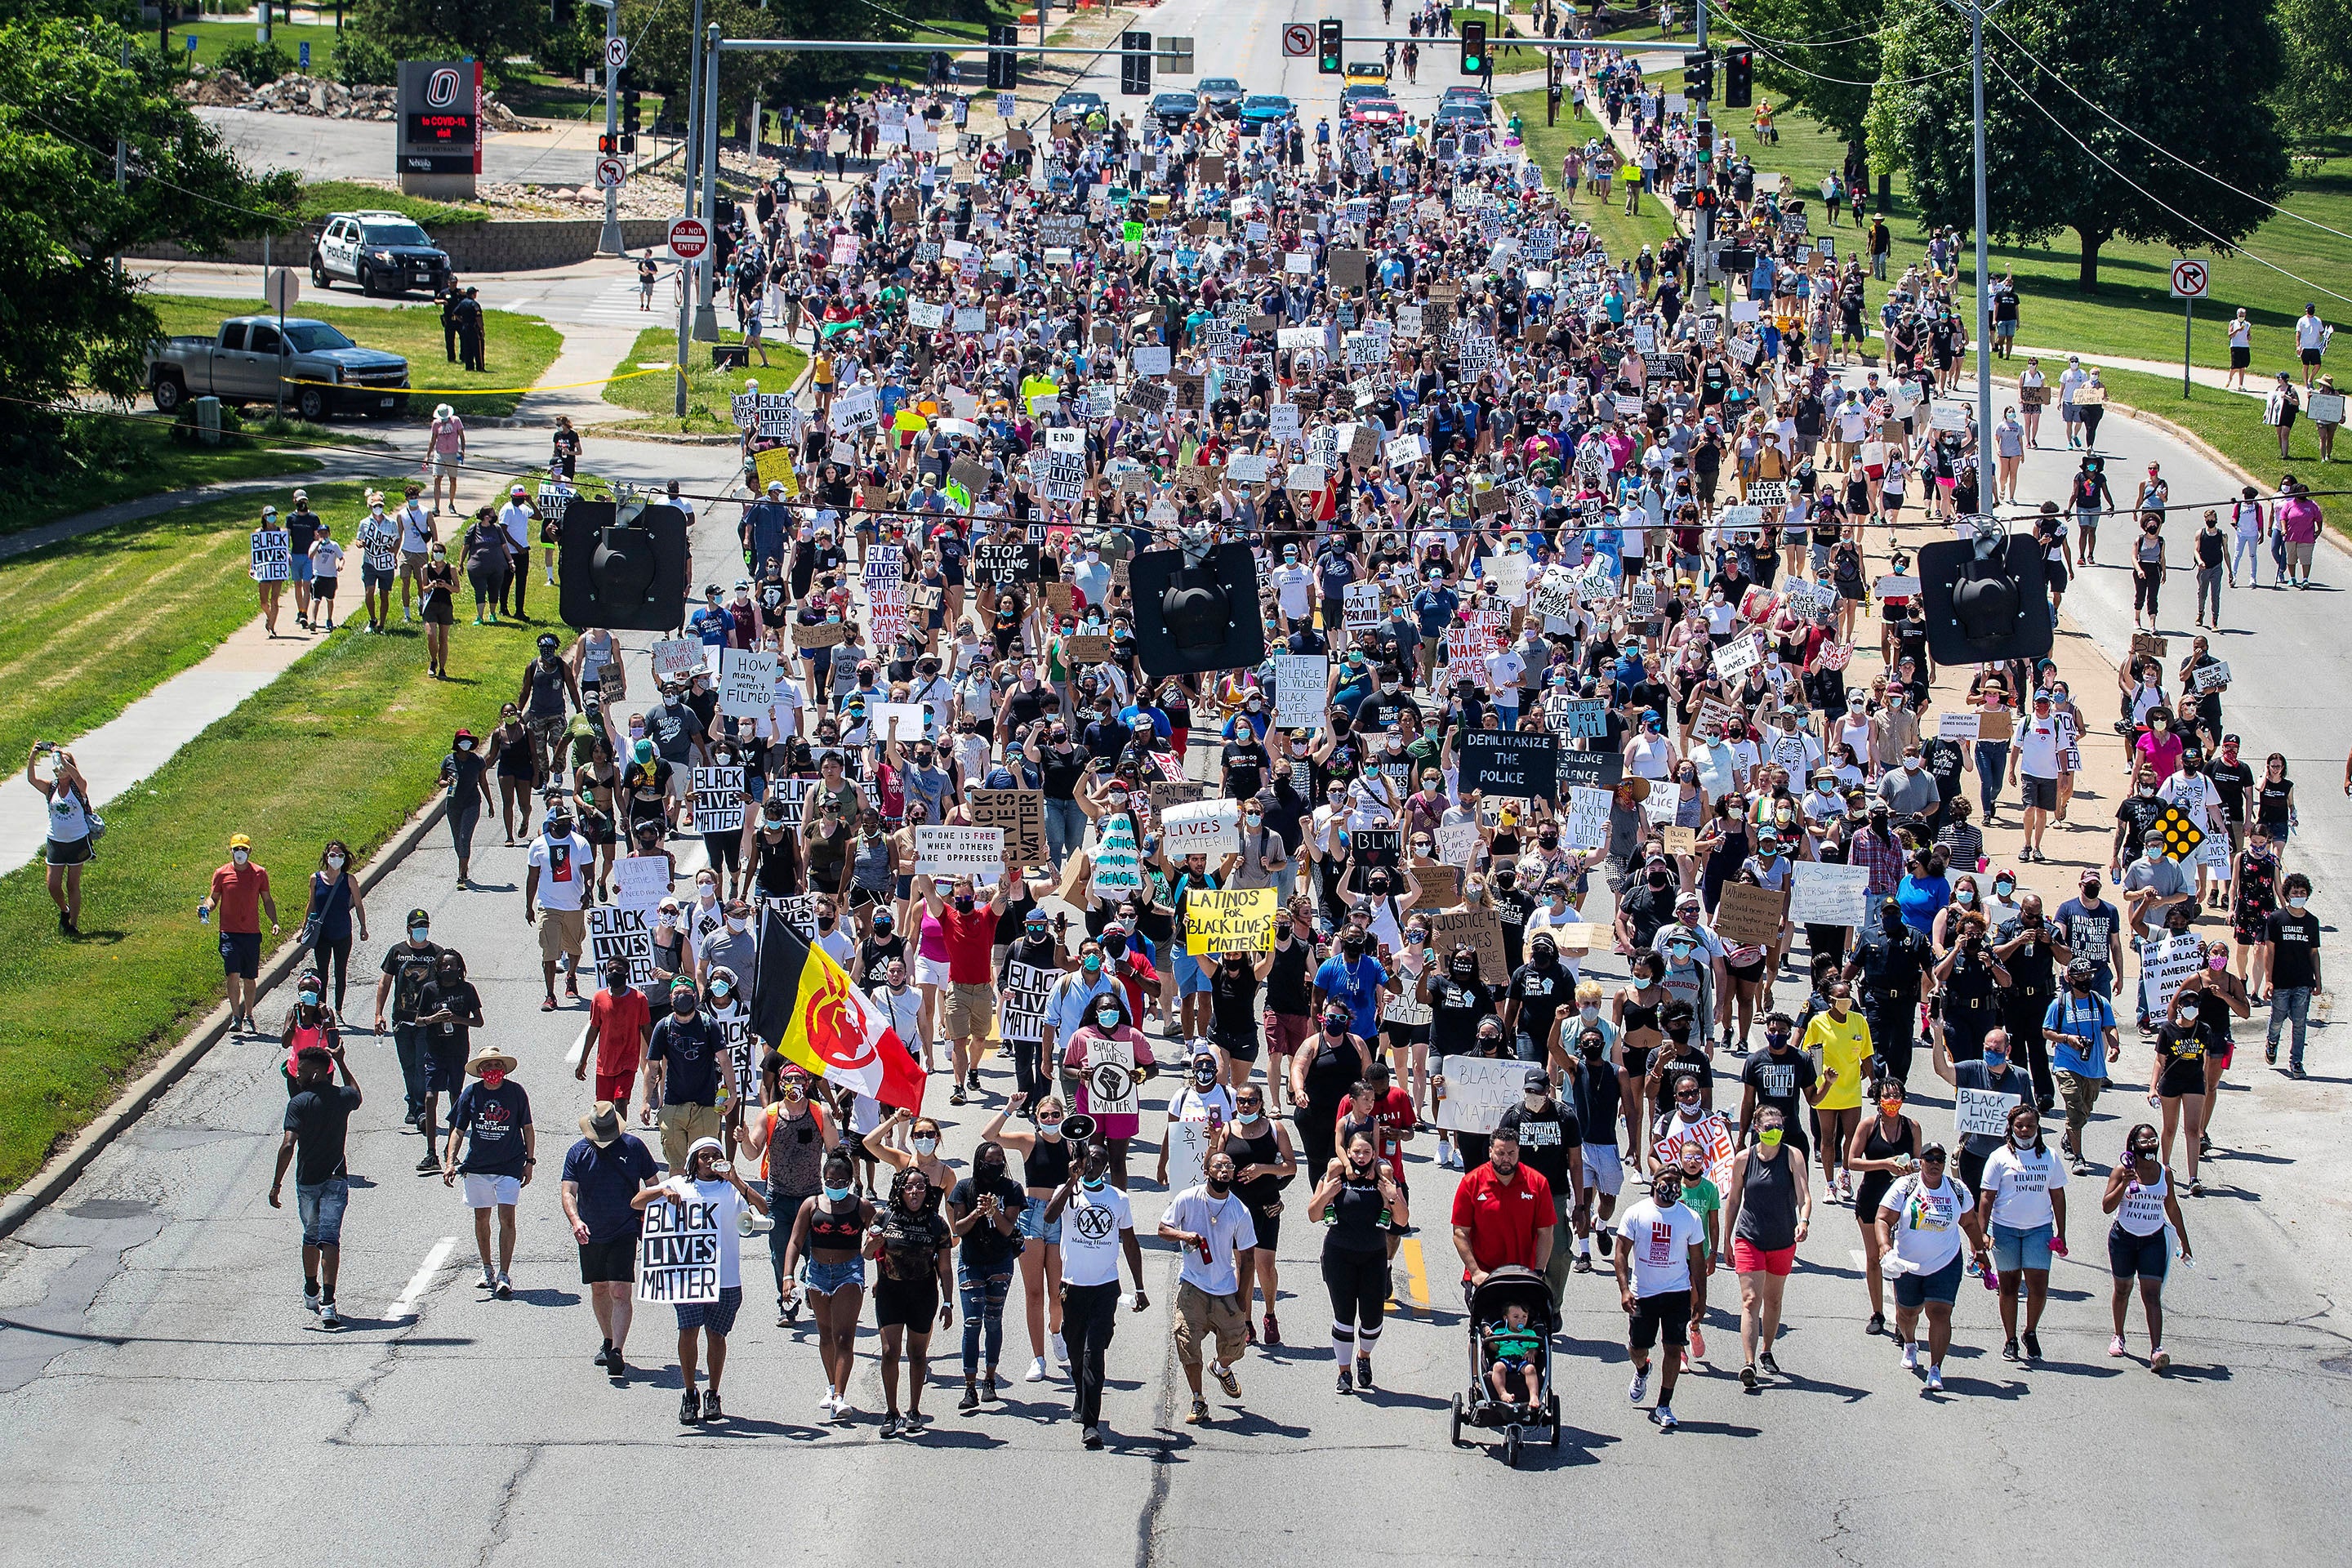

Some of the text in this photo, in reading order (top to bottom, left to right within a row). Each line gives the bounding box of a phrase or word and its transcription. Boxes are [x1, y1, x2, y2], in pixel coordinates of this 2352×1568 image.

[421, 117, 430, 127] to
[437, 128, 452, 138] visit
[1040, 216, 1067, 228] Want
[675, 227, 702, 235] DO NOT
[1530, 229, 1551, 238] BLACK
[677, 243, 700, 252] ENTER
[1530, 238, 1552, 248] LIVES
[327, 246, 351, 262] POLICE
[1530, 247, 1552, 259] MATTER
[911, 307, 941, 317] JUSTICE
[912, 318, 939, 326] PEACE
[1206, 320, 1230, 332] BLACK
[1209, 332, 1230, 344] LIVES
[1348, 338, 1380, 349] JUSTICE
[1636, 339, 1653, 350] NOW
[1354, 350, 1379, 362] PEACE
[1461, 346, 1488, 358] BLACK
[1463, 358, 1487, 370] LIVES
[760, 394, 792, 408] BLACK
[762, 409, 791, 421] LIVES
[842, 411, 873, 428] JAMES
[760, 422, 791, 436] MATTER
[1053, 433, 1075, 443] END
[1051, 452, 1085, 468] BLACK
[1049, 467, 1085, 483] LIVES
[1046, 482, 1081, 500] MATTER
[1747, 482, 1782, 491] BLACK
[1751, 489, 1784, 498] LIVES
[1748, 497, 1787, 506] MATTER
[252, 533, 287, 549] BLACK
[253, 548, 286, 564] LIVES
[867, 546, 898, 562] BLACK
[981, 546, 1023, 557] STOP
[975, 557, 1030, 570] KILLING
[991, 568, 1015, 583] US
[1583, 576, 1605, 588] NO
[871, 591, 889, 603] SAY
[1354, 586, 1363, 596] I
[1581, 586, 1614, 599] PEACE
[1634, 587, 1655, 596] BLACK
[1345, 596, 1376, 608] CAN'T
[1635, 596, 1654, 605] LIVES
[871, 604, 906, 617] NAME
[1633, 605, 1654, 613] MATTER
[871, 618, 907, 632] JAMES
[1448, 629, 1481, 643] SAY HIS
[1450, 644, 1481, 658] NAME
[1717, 638, 1751, 658] JUSTICE
[2135, 637, 2165, 654] BLM
[666, 654, 693, 670] NAMES
[738, 657, 772, 672] HOW
[1277, 657, 1308, 669] WHITE
[1451, 659, 1485, 673] JAMES
[1723, 657, 1747, 673] JAMES
[733, 672, 755, 683] many
[1278, 669, 1321, 679] SILENCE
[1279, 679, 1328, 689] IS VIOLENCE
[726, 689, 771, 703] FILMED
[1278, 693, 1307, 702] BLACK
[1379, 706, 1393, 714] THE
[1570, 701, 1605, 712] JUSTICE
[1279, 713, 1319, 724] MATTER
[1379, 712, 1398, 721] HOPE
[1579, 712, 1597, 722] FOR
[1576, 724, 1602, 737] ALL
[1468, 734, 1550, 750] DEMILITARIZE
[1494, 752, 1520, 765] THE
[1565, 752, 1603, 764] SILENCE
[694, 768, 743, 789] BLACK
[1480, 771, 1525, 785] POLICE
[697, 791, 742, 809] LIVES
[1579, 790, 1604, 806] PETE
[1572, 802, 1610, 817] RICKETTS
[694, 810, 741, 832] MATTER
[1019, 793, 1038, 861] MATTER
[1111, 817, 1125, 831] NO
[1582, 815, 1597, 826] IS A
[922, 831, 933, 840] NO
[938, 831, 957, 840] ONE
[973, 832, 996, 840] FREE
[1169, 822, 1221, 838] LIVES
[1575, 825, 1603, 839] LITTLE
[1169, 836, 1232, 853] MATTER!!!
[1357, 831, 1400, 858] BLM!
[1576, 835, 1599, 845] BITCH
[926, 843, 995, 851] WHEN OTHERS
[921, 854, 999, 862] ARE OPPRESSED
[1109, 855, 1126, 867] NO
[1098, 871, 1136, 887] PEACE
[1189, 889, 1259, 908] LATINOS
[1223, 907, 1244, 918] FOR
[591, 908, 646, 934] BLACK
[1187, 915, 1271, 935] BLACK LIVES
[1437, 914, 1485, 931] JUSTICE
[1488, 912, 1496, 927] 4
[2072, 915, 2110, 926] INJUSTICE
[2072, 924, 2109, 935] ANYWHERE
[2282, 925, 2304, 933] LEGALIZE
[1208, 932, 1271, 952] MATTER!!
[1447, 931, 1492, 952] JAMES
[2080, 933, 2086, 942] A
[594, 936, 650, 960] LIVES
[2072, 940, 2108, 952] TO JUSTICE
[2144, 937, 2196, 956] WHY DOES
[2070, 948, 2108, 960] EVERYWHERE
[2143, 949, 2203, 967] BEING BLACK
[2145, 963, 2203, 980] IN AMERICA
[1093, 1040, 1120, 1053] BLACK
[1099, 1050, 1129, 1064] LIVES
[1459, 1064, 1510, 1086] BLACK
[1764, 1064, 1794, 1075] STRAIGHT
[1765, 1075, 1793, 1088] OUTTA
[1488, 1087, 1521, 1104] LIVES
[1769, 1086, 1788, 1098] OMAHA
[1093, 1099, 1133, 1113] MATTER
[1961, 1092, 2005, 1108] BLACK
[475, 1123, 510, 1131] CHURCH
[1520, 1125, 1557, 1136] EQUALITY
[1689, 1116, 1724, 1139] HIS
[1686, 1197, 1708, 1206] PUBLIC
[646, 1201, 719, 1234] BLACK
[1071, 1237, 1092, 1245] Making
[644, 1235, 716, 1266] LIVES
[642, 1267, 716, 1301] MATTER
